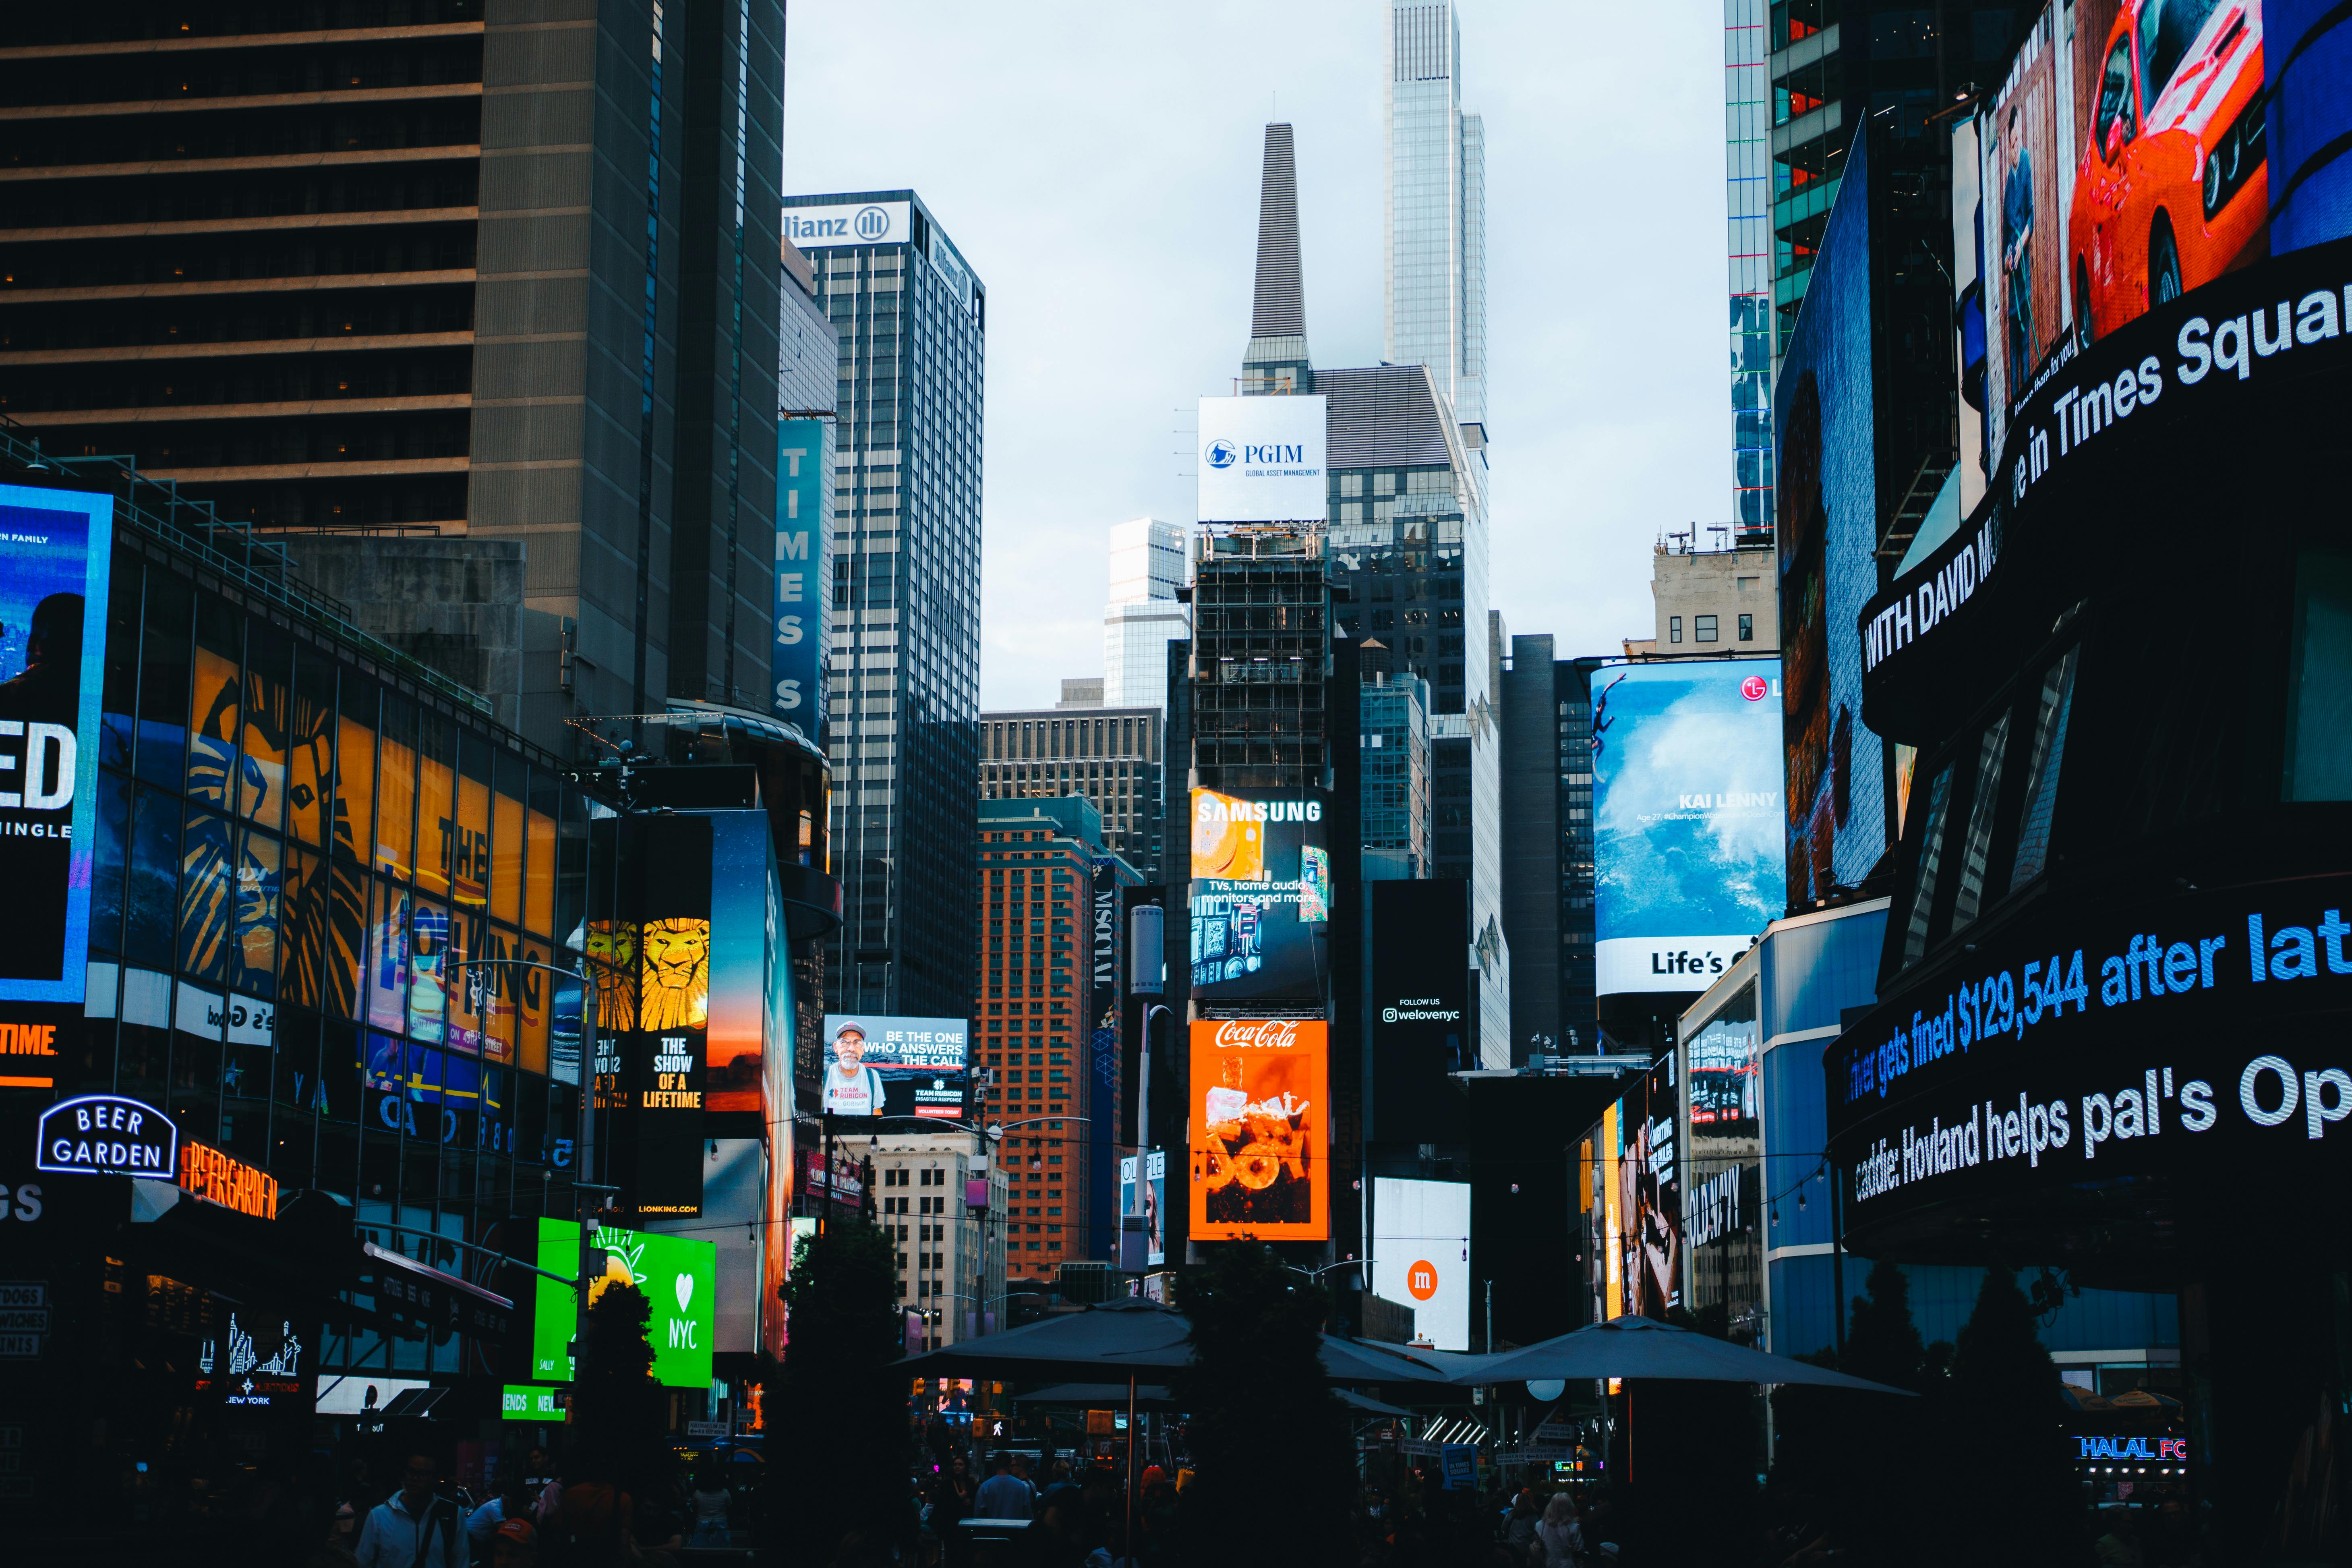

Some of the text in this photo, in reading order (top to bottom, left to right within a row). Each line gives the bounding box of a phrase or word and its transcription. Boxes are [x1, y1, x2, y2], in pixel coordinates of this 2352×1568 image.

[934, 240, 958, 289] Allianz
[2050, 357, 2059, 376] for
[2060, 339, 2073, 367] you.
[2031, 425, 2049, 484] in
[2054, 355, 2164, 457] Times
[1244, 445, 1304, 464] PGIM
[12, 534, 49, 544] FAMILY
[776, 448, 809, 644] TIMES
[1864, 594, 1913, 673] WITH
[1919, 544, 1975, 636] DAVID
[1679, 792, 1778, 809] KAI LENNY
[1198, 802, 1321, 822] SAMSUNG
[1636, 814, 1651, 822] Age
[1652, 813, 1662, 822] 27,
[438, 816, 487, 884] THE
[1209, 880, 1309, 891] TVs, home audio,
[1201, 892, 1319, 903] monitors and more.
[1652, 951, 1723, 974] Life's
[1878, 1026, 1908, 1098] gets
[1911, 994, 1954, 1068] fined
[1959, 949, 2089, 1053] $129,544
[2101, 934, 2226, 1007] after
[2248, 909, 2352, 983] lat
[1398, 1009, 1460, 1022] welovenyc
[412, 1019, 442, 1037] ENTRANCE
[450, 1028, 460, 1041] ON
[886, 1031, 963, 1043] BE THE ONE
[661, 1037, 687, 1054] THE
[863, 1042, 963, 1055] WHO ANSWERS
[653, 1055, 693, 1073] SHOW
[902, 1054, 963, 1067] THE CALL
[658, 1073, 687, 1090] OF A
[643, 1092, 701, 1108] LIFETIME
[76, 1106, 143, 1136] BEER
[1855, 1054, 2352, 1202] caddie: Hovland helps pal's Op
[52, 1139, 161, 1168] GARDEN
[1648, 1141, 1673, 1174] THE RULES
[1689, 1163, 1739, 1248] OLD NAVY
[1414, 1271, 1431, 1290] m
[3, 1288, 38, 1304] DOGS
[669, 1318, 698, 1349] NYC
[539, 1359, 555, 1370] SALLY
[255, 1382, 300, 1392] ARTOIS
[247, 1397, 270, 1405] YORK
[2081, 1438, 2155, 1458] HALAL
[1450, 1467, 1470, 1475] SQUARE
